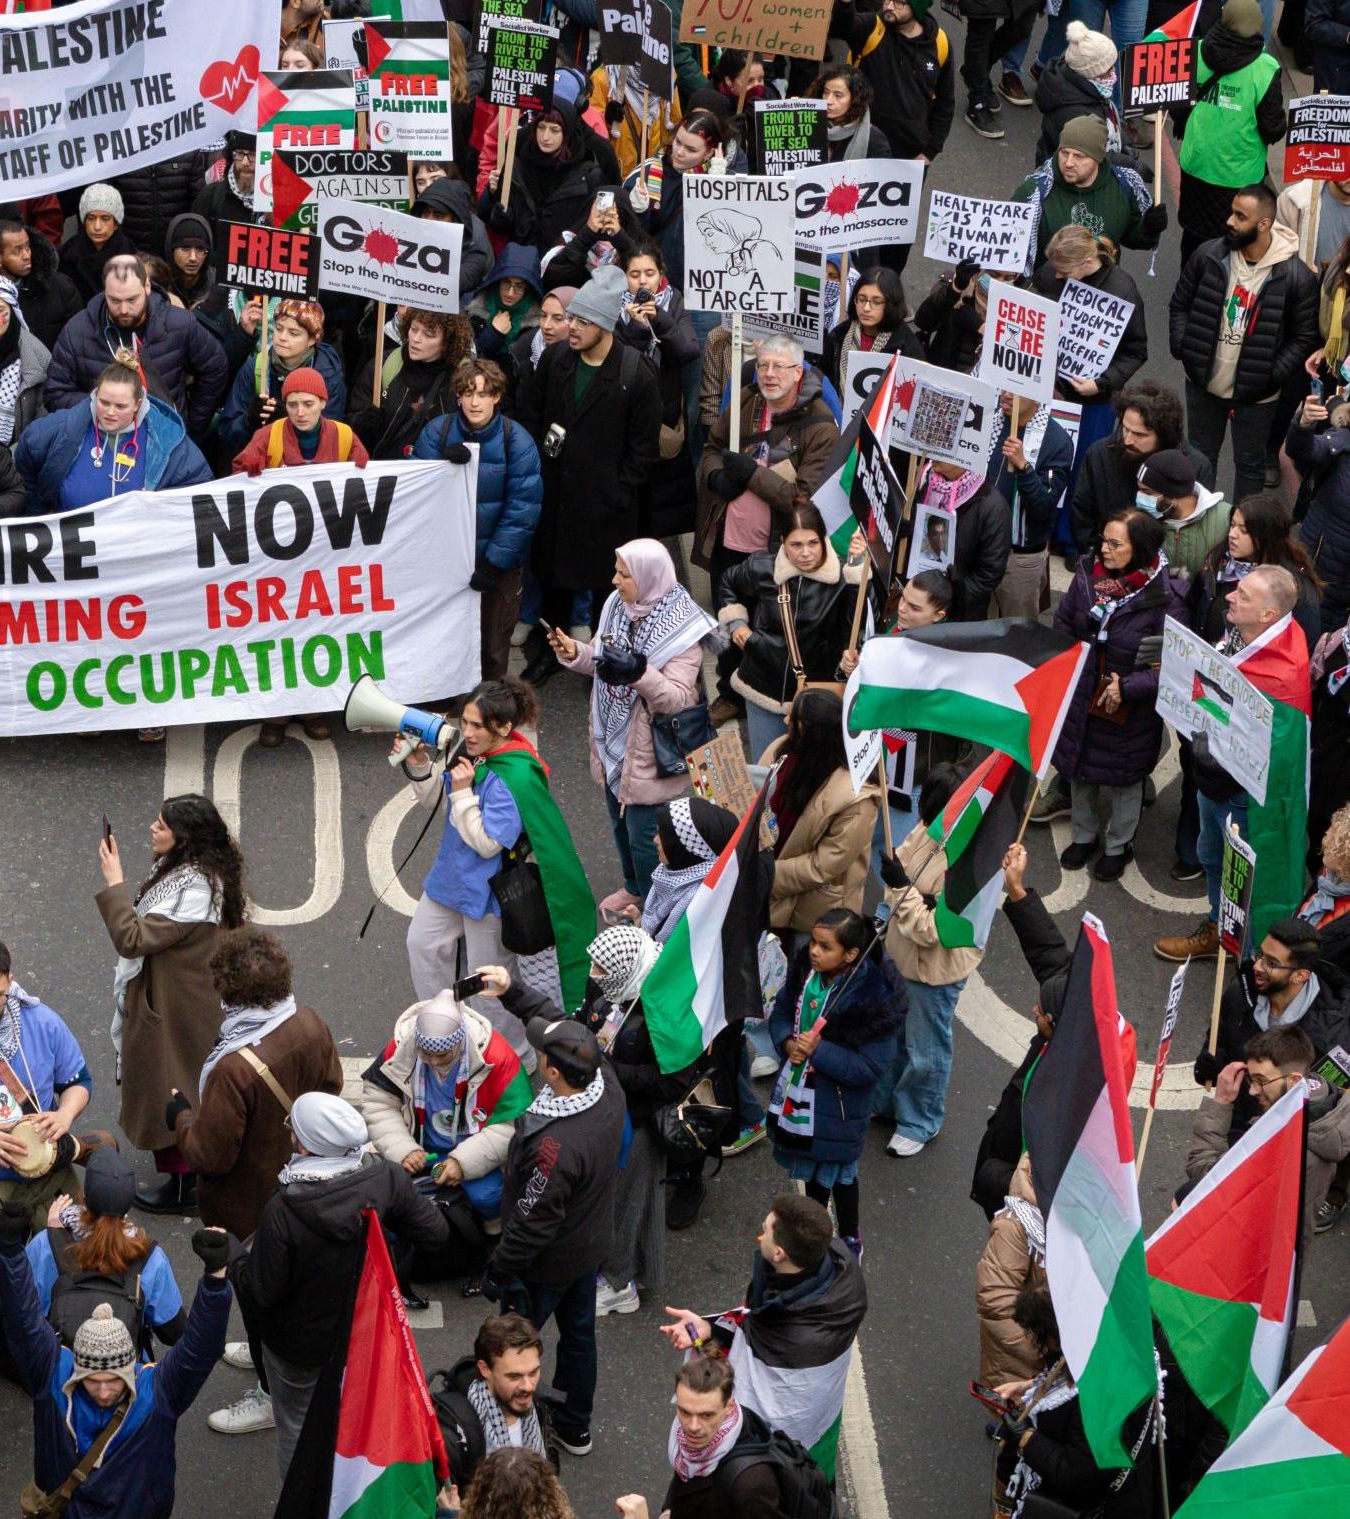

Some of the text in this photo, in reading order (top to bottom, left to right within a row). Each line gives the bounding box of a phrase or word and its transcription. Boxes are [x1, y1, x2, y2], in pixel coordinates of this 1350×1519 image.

[481, 0, 523, 17] THE SEA
[763, 6, 826, 19] women
[500, 22, 550, 35] Socialist Worker
[496, 30, 550, 50] FROM THE
[714, 27, 816, 57] children
[494, 43, 543, 60] RIVER TO
[493, 55, 537, 72] THE SEA
[1132, 40, 1192, 86] FREE
[379, 71, 438, 96] FREE
[491, 79, 534, 96] WILL BE
[492, 67, 548, 87] PALESTINE
[68, 84, 125, 121] WITH
[130, 72, 176, 105] THE
[490, 91, 516, 106] FREE
[1131, 81, 1190, 106] PALESTINE
[1300, 98, 1349, 106] Socialist Worker
[372, 98, 448, 113] PALESTINE
[766, 102, 817, 110] Socialist Worker
[1295, 107, 1350, 124] FREEDOM
[764, 111, 818, 126] FROM THE
[1317, 121, 1328, 129] for
[58, 138, 88, 170] OF
[95, 102, 207, 163] PALESTINE
[272, 123, 342, 148] FREE
[764, 124, 813, 138] RIVER TO
[765, 138, 809, 151] THE SEA
[1298, 147, 1340, 161] الحرية
[295, 153, 392, 175] DOCTORS
[765, 149, 821, 164] PALESTINE
[1292, 159, 1346, 175] لفلسطين
[765, 164, 790, 176] WILL
[316, 178, 406, 199] AGAINST
[686, 178, 789, 202] HOSPITALS
[934, 194, 1032, 220] HEALTHCARE
[820, 216, 909, 236] the massacre
[953, 211, 992, 228] IS A
[950, 225, 1012, 245] HUMAN
[228, 223, 310, 276] FREE
[948, 241, 1010, 264] RIGHT
[226, 263, 307, 294] PALESTINE
[323, 259, 451, 297] Stop the massacre
[689, 269, 764, 291] NOT A
[695, 288, 788, 311] TARGET
[1063, 282, 1126, 322] MEDICAL
[998, 298, 1047, 333] CEASE
[1060, 302, 1123, 338] STUDENTS
[1068, 323, 1095, 343] SAY
[992, 344, 1042, 378] NOW!
[870, 443, 889, 504] Free
[856, 450, 894, 553] Palestine
[191, 475, 398, 569] NOW
[205, 563, 395, 630] ISRAEL
[1163, 627, 1224, 682] STOP THE
[25, 629, 386, 712] OCCUPATION
[853, 743, 870, 769] Stop
[1234, 852, 1249, 878] THE
[1233, 869, 1244, 890] TO
